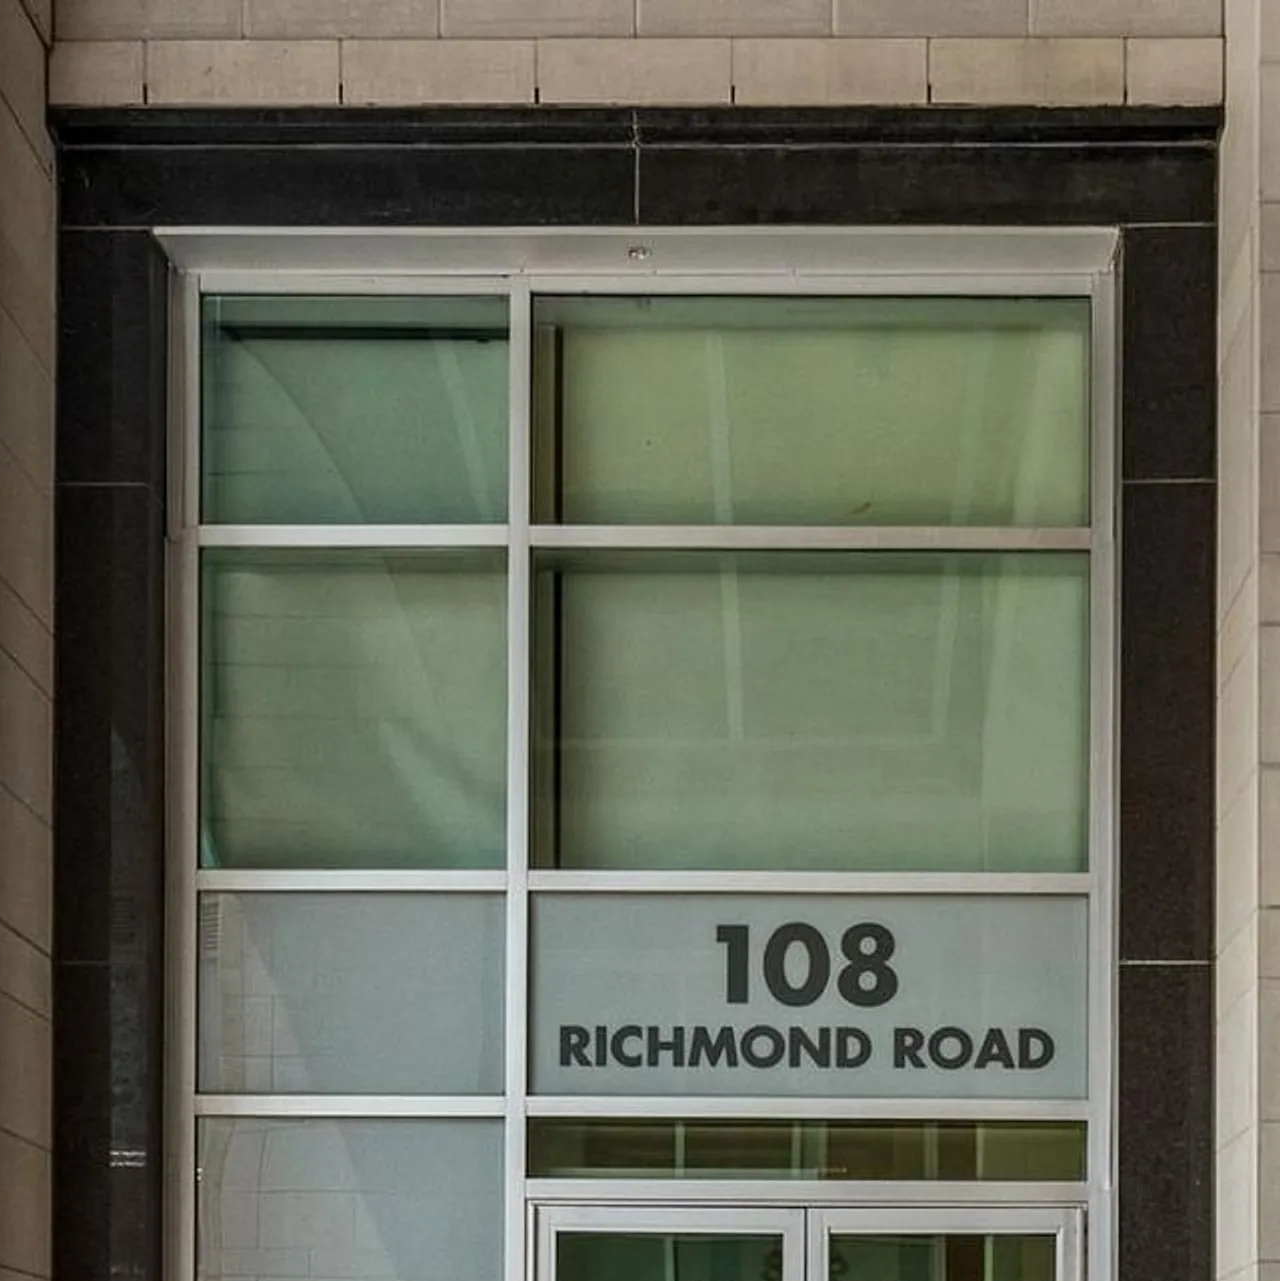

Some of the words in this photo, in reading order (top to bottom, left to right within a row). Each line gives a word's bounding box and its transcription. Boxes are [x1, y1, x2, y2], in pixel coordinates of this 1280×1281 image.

[715, 921, 899, 1008] 108
[559, 1024, 873, 1070] RICHMOND
[893, 1025, 1056, 1071] ROAD
